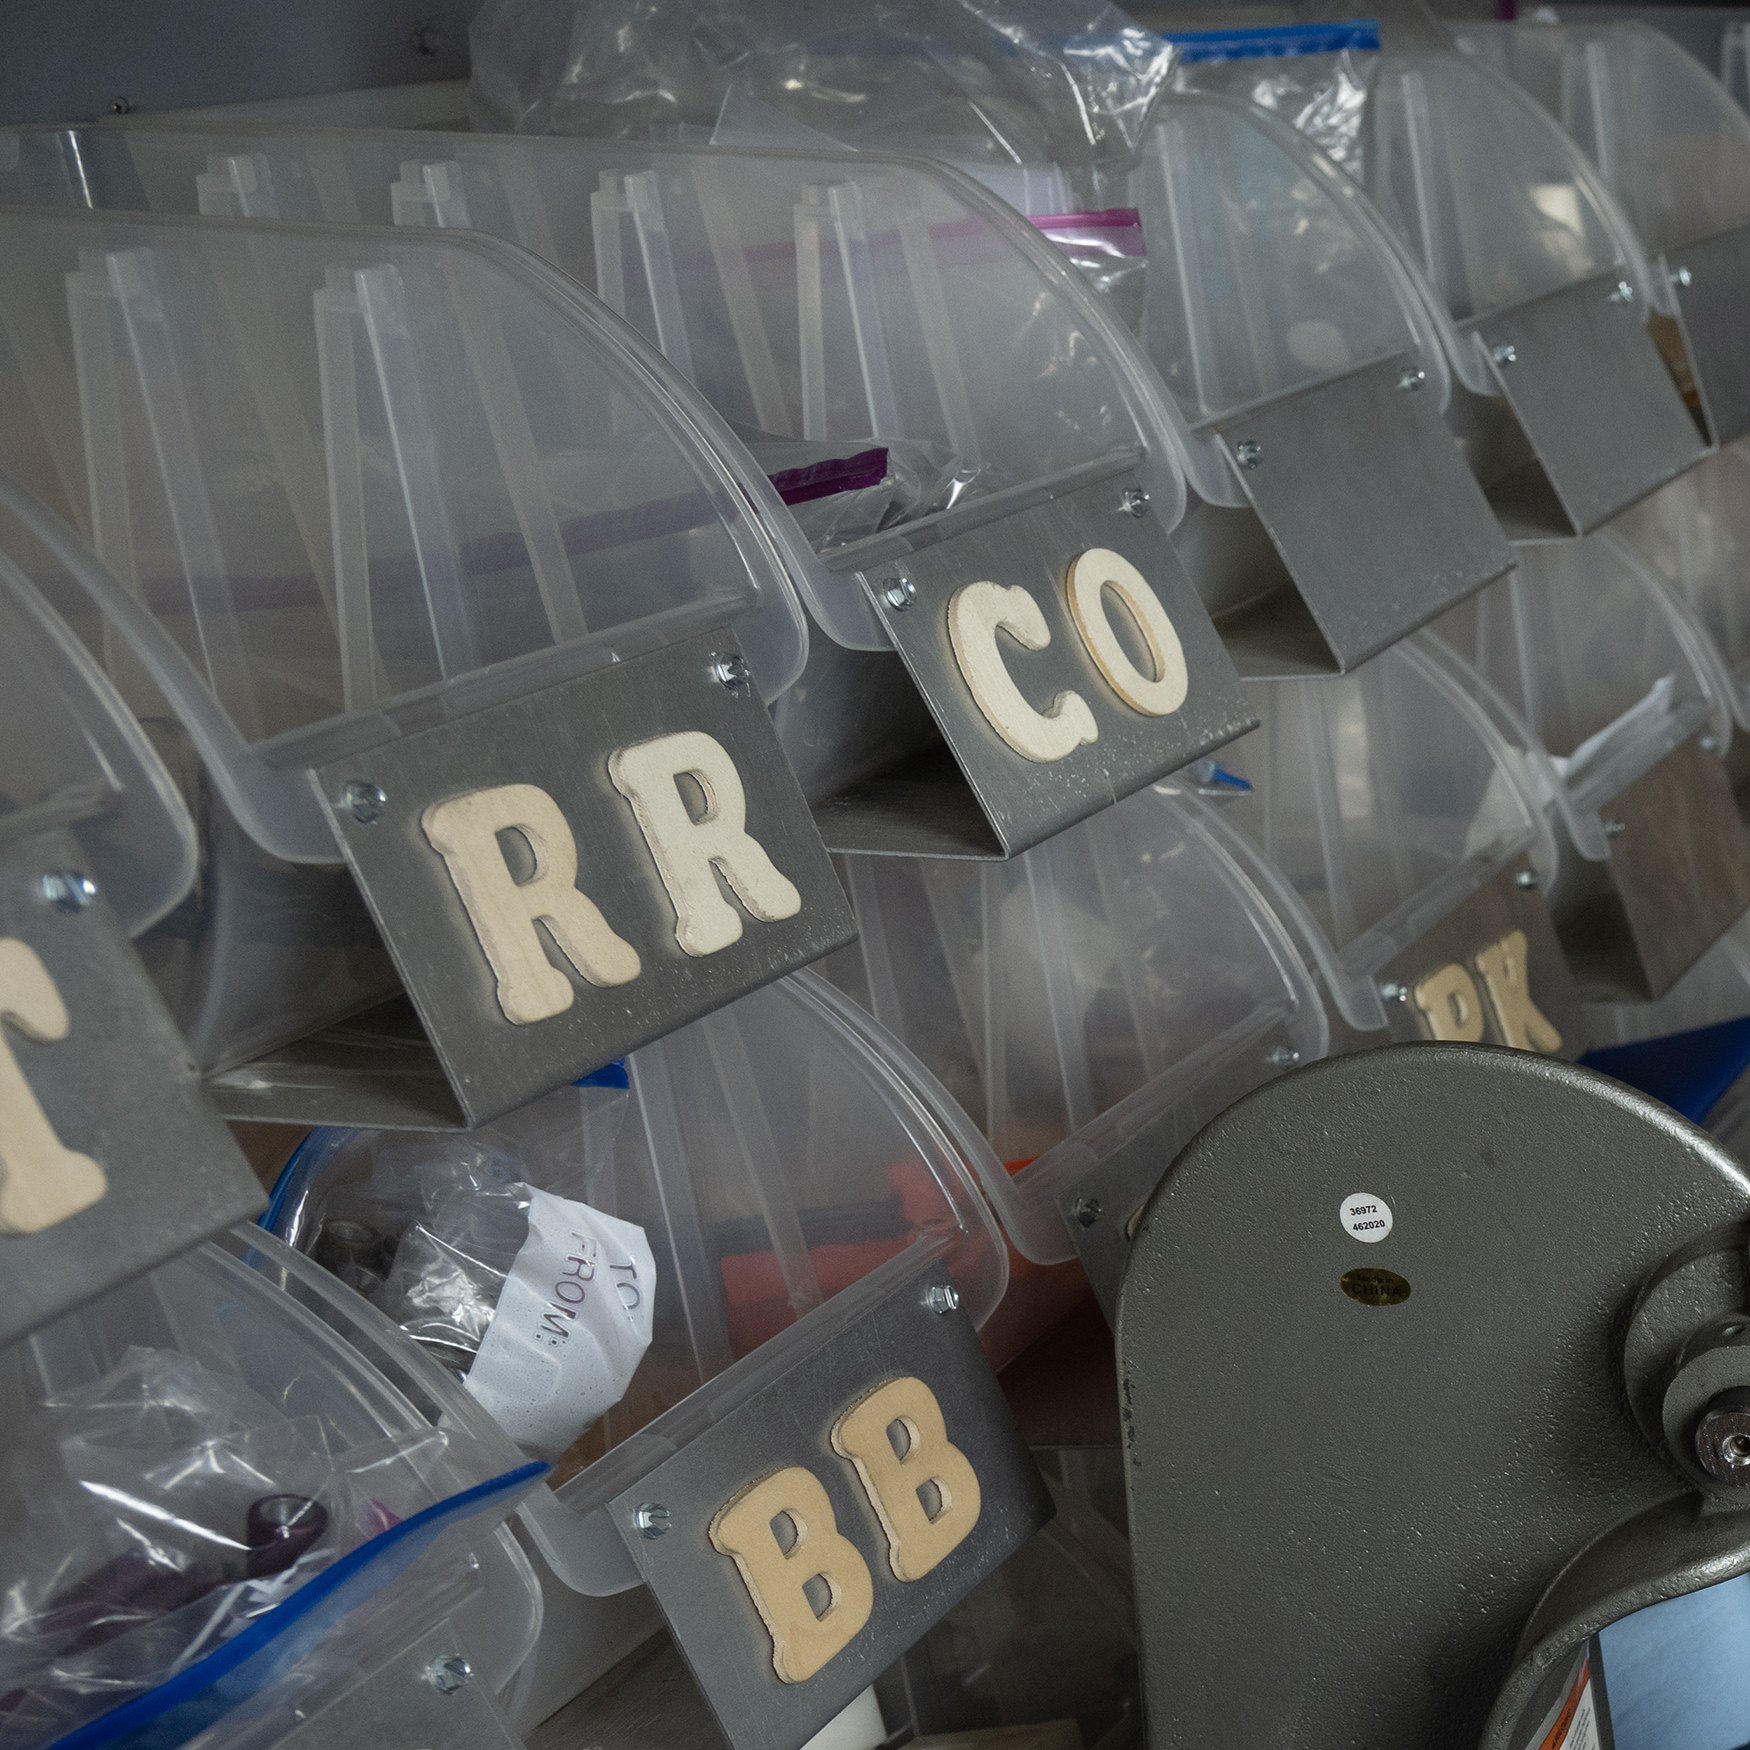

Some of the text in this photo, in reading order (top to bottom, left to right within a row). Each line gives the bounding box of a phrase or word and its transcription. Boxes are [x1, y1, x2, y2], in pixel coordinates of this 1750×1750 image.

[947, 548, 1188, 764] CO
[420, 730, 802, 1026] RR
[1349, 1205, 1378, 1216] 36972
[1352, 1219, 1386, 1231] 462020
[1351, 1283, 1402, 1297] CHINA
[708, 1376, 981, 1685] BB
